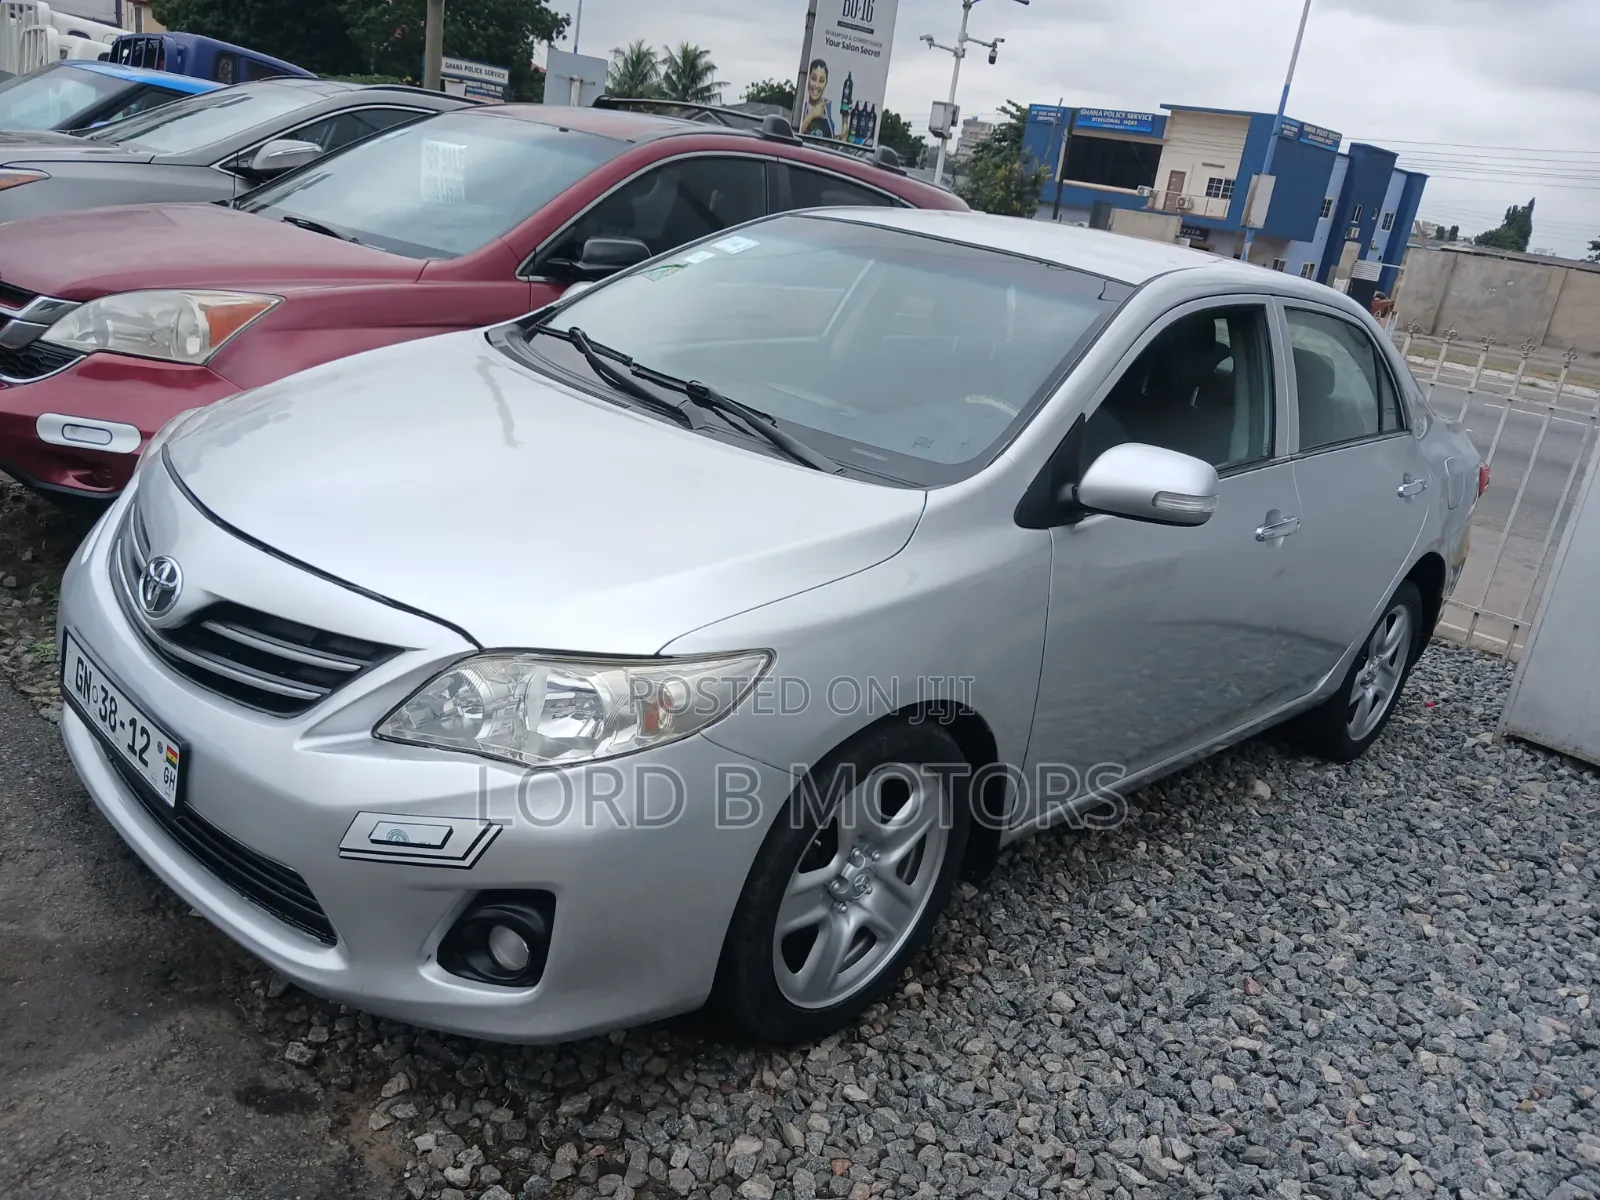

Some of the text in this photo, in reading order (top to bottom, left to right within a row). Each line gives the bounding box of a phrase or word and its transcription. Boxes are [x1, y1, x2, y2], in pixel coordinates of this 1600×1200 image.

[825, 29, 848, 40] SHAMPOO
[825, 37, 881, 58] Your Salon Secret
[445, 62, 506, 79] GHANA POLICE SERVICE
[1080, 109, 1153, 121] GHANA POLICE SERVICE
[1091, 116, 1121, 124] DIVISIONAL
[75, 655, 151, 768] GN 38-12
[163, 767, 176, 791] GH
